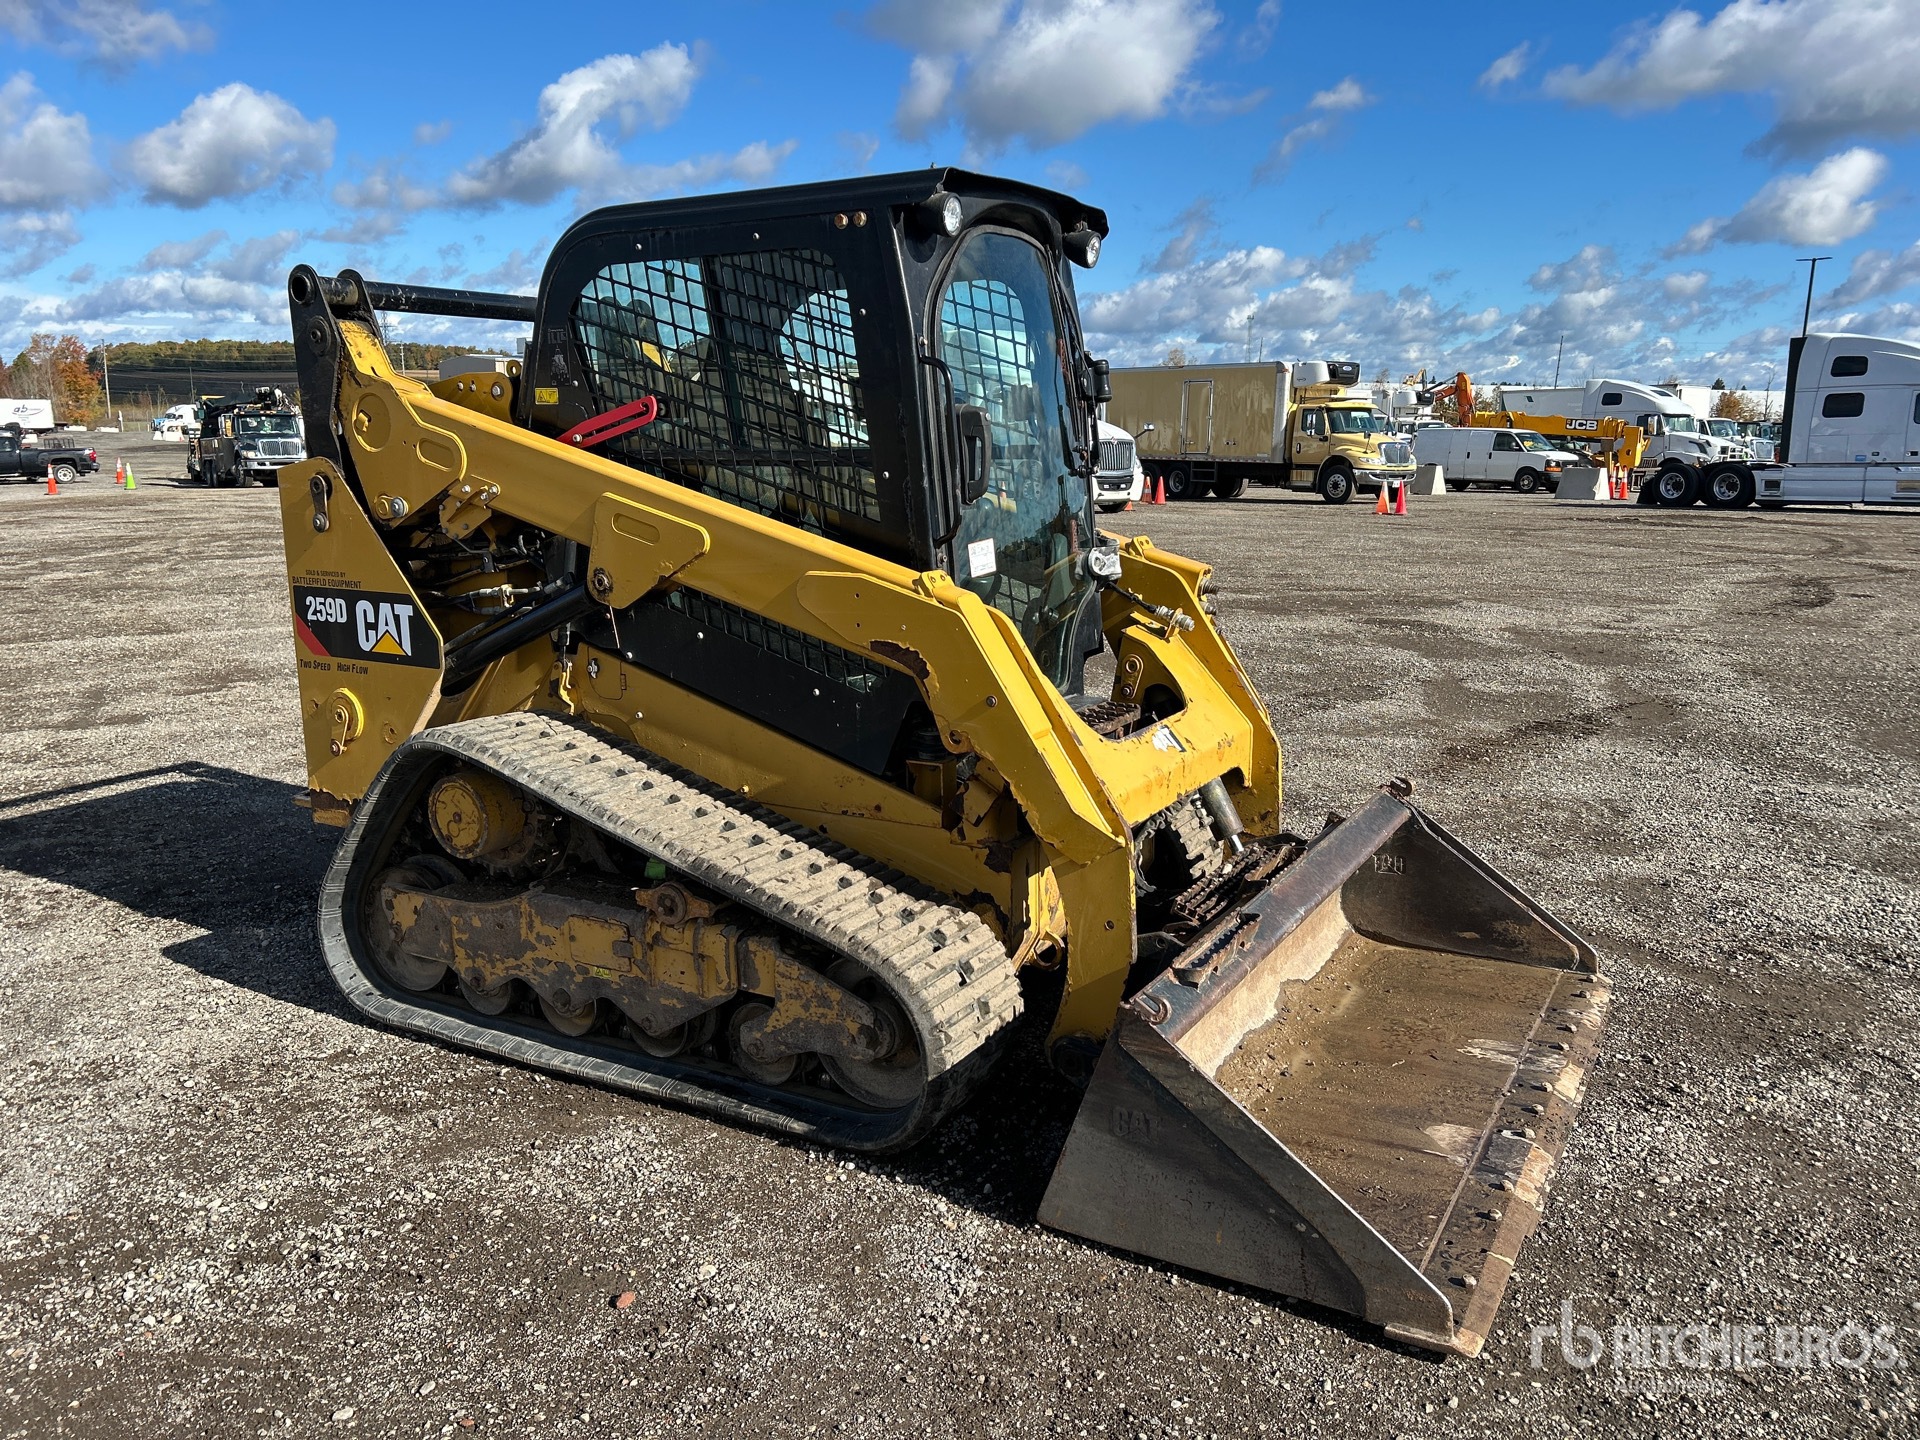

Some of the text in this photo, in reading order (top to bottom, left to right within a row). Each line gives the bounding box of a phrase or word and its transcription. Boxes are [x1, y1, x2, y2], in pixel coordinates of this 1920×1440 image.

[1566, 419, 1598, 430] JCB
[327, 578, 362, 589] EQUIPMENT
[306, 595, 347, 623] 259D
[355, 599, 414, 657] CAT
[1112, 1106, 1161, 1144] CAT
